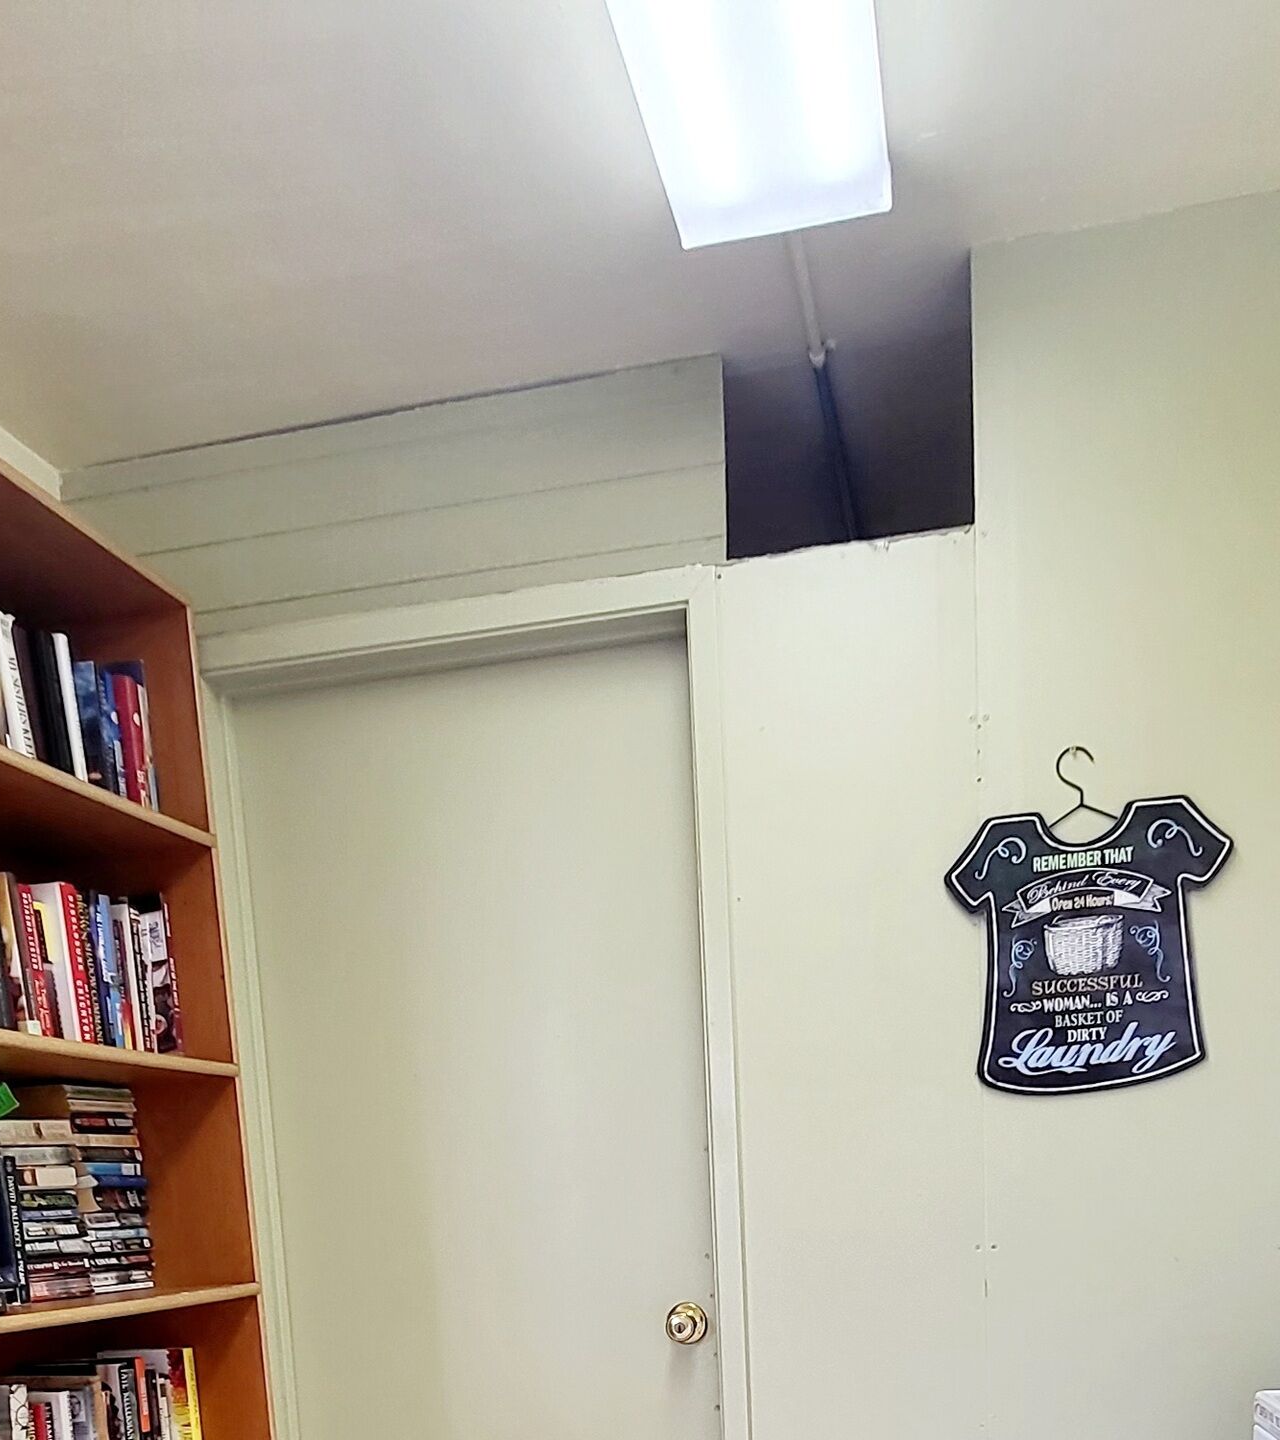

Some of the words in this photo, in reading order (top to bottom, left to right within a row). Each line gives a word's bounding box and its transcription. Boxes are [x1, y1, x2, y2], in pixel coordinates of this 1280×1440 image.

[1032, 850, 1102, 872] REMEMBER
[1103, 846, 1134, 865] THAT
[1026, 873, 1090, 904] Behind
[1091, 871, 1142, 892] Every
[1052, 896, 1073, 911] Open
[1073, 896, 1085, 909] 24
[67, 894, 84, 971] DISCLOSURE
[1031, 974, 1143, 996] SUCCESSFUL
[75, 979, 91, 1041] CRICHTON
[1042, 994, 1102, 1013] WOMAN...
[1105, 991, 1119, 1007] IS
[1121, 989, 1134, 1006] A
[1054, 1011, 1103, 1028] BASKET
[1105, 1009, 1124, 1024] OF
[1067, 1026, 1108, 1043] DIRTY
[998, 1021, 1176, 1076] Laundry
[7, 1175, 17, 1203] DAVID
[11, 1204, 22, 1248] BALDACCI
